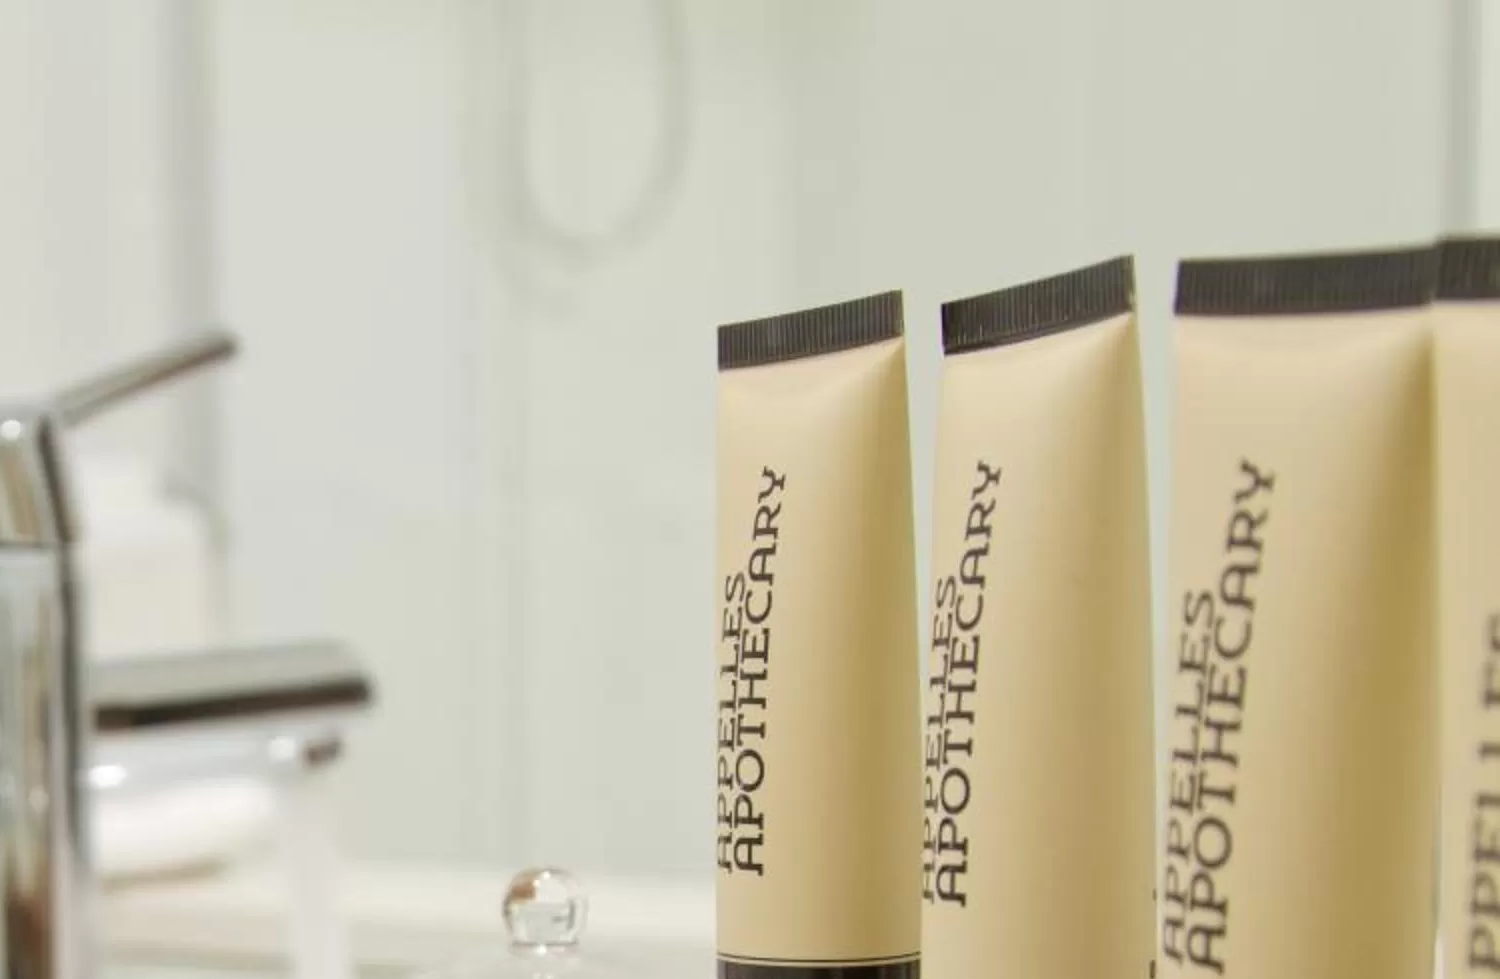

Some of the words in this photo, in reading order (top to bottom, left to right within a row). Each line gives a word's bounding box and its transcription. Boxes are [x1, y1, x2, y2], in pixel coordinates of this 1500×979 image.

[717, 572, 746, 873] APPELLES
[733, 466, 787, 877] APOTHECARY
[936, 460, 1002, 908] APOTHECARY
[1162, 589, 1215, 968] APPELLES
[1186, 456, 1276, 978] APOTHECARY
